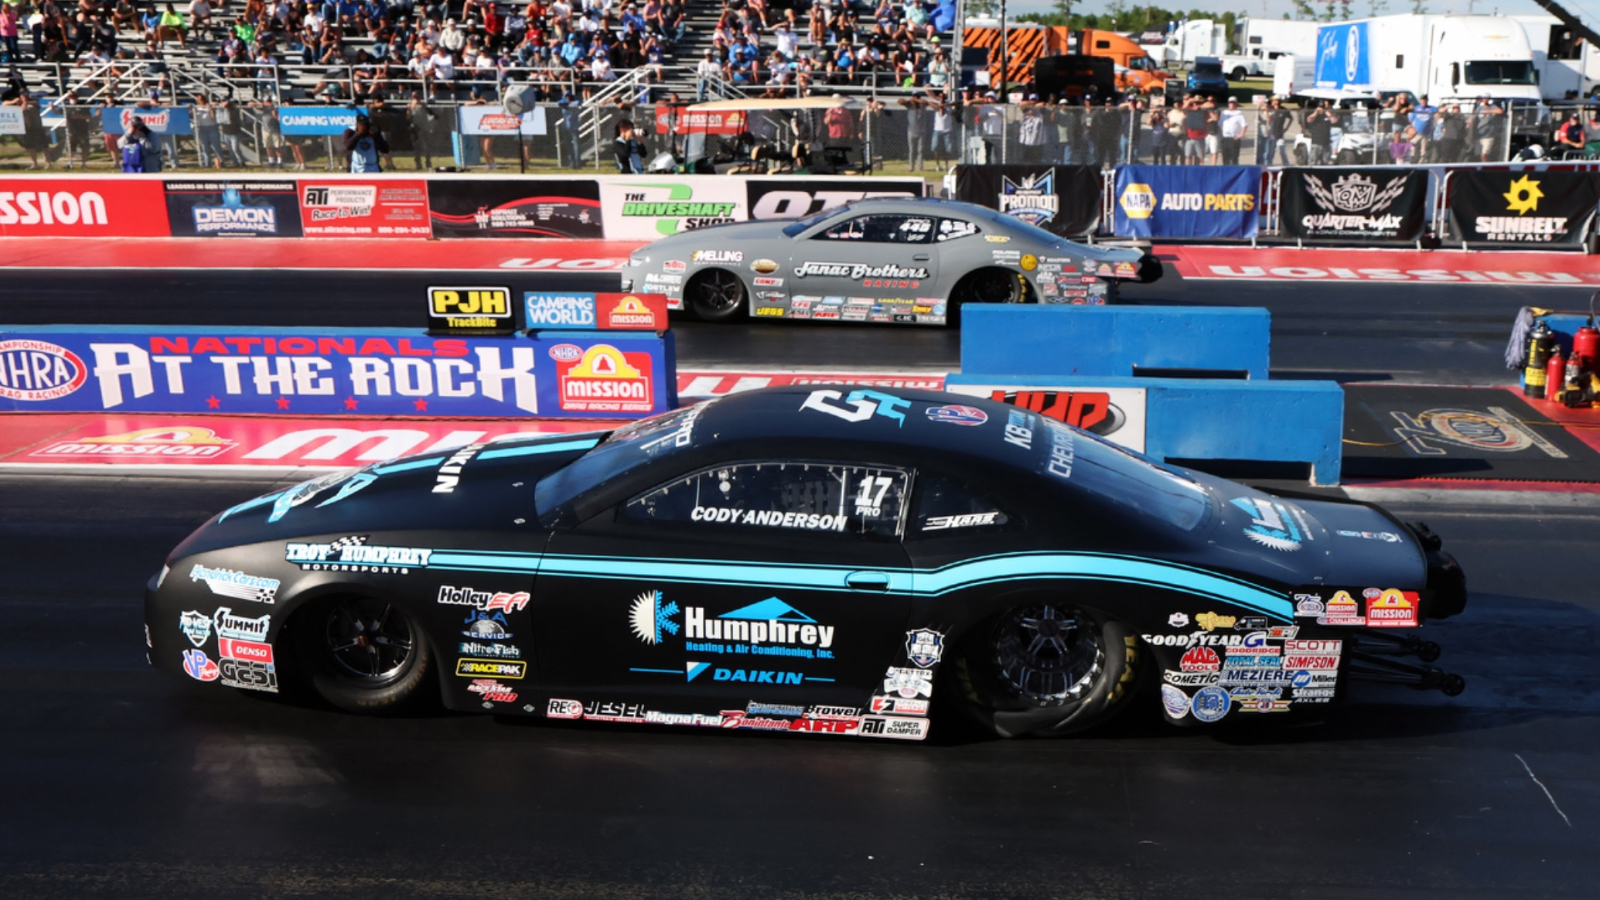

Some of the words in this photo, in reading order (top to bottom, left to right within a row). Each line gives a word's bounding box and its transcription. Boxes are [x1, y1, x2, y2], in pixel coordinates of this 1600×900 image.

[282, 115, 326, 126] CAMPING
[306, 187, 328, 205] ATI
[331, 189, 373, 197] PERFORMANCE
[1126, 192, 1151, 208] NAPA
[622, 203, 735, 216] DRIVESHAFT
[752, 191, 916, 220] OT
[1161, 193, 1203, 211] AUTO
[1205, 193, 1255, 212] PARTS
[195, 208, 275, 223] DEMON
[312, 208, 336, 221] Race
[338, 207, 348, 218] to
[349, 205, 372, 217] Win!
[197, 222, 276, 233] PERFORMANCE
[1302, 213, 1403, 230] QUARTER-MAX
[1475, 216, 1567, 234] SUNBELT
[1487, 233, 1552, 242] RENTALS
[696, 250, 744, 262] MELLING
[794, 262, 850, 277] Janac
[851, 264, 929, 279] Brothers
[863, 280, 919, 289] RACING
[434, 290, 506, 314] PJH
[527, 295, 593, 309] CAMPING
[446, 317, 497, 328] TrackBite
[529, 308, 594, 325] WORLD
[611, 314, 653, 324] MISSION
[149, 337, 469, 356] NATIONALS
[553, 347, 580, 358] NHRA
[89, 343, 192, 409] AT
[210, 355, 336, 396] THE
[349, 347, 538, 414] ROCK
[28, 386, 68, 400] RACING
[566, 379, 644, 399] MISSION
[620, 403, 652, 411] SERIES
[50, 444, 222, 456] MISSION
[854, 476, 893, 508] 17
[855, 506, 881, 517] PRO
[690, 506, 742, 524] CODY
[742, 509, 847, 532] ANDERSON
[286, 543, 331, 562] TROY
[340, 545, 433, 566] HUMPHREY
[302, 563, 409, 575] MOTORSPORTS
[440, 587, 489, 608] Holley
[1370, 609, 1412, 619] MISSION
[215, 609, 266, 634] SUMMIT
[685, 606, 835, 648] Humphrey
[463, 630, 513, 639] SERVICE
[1141, 632, 1242, 649] GOODYEAR
[236, 645, 267, 657] DENSO
[686, 641, 724, 654] Heating
[726, 645, 733, 653] &
[735, 644, 749, 654] Air
[751, 644, 815, 659] Conditioning,
[816, 649, 835, 659] Inc.
[1286, 640, 1341, 650] SCOTT
[1182, 647, 1220, 664] MAC
[1227, 656, 1256, 667] TOTAL
[1259, 656, 1282, 667] SEAL
[1286, 656, 1337, 669] SIMPSON
[471, 663, 521, 674] RACEPAK
[1182, 664, 1219, 672] TOOLS
[713, 668, 803, 685] DAIKIN
[1228, 670, 1293, 681] MEZIERE
[1312, 675, 1337, 683] Miller
[646, 710, 723, 726] MagnaFuel
[892, 721, 920, 729] SUPER
[791, 719, 859, 733] ARP
[862, 719, 886, 734] ATI
[887, 727, 922, 736] DAMPER
